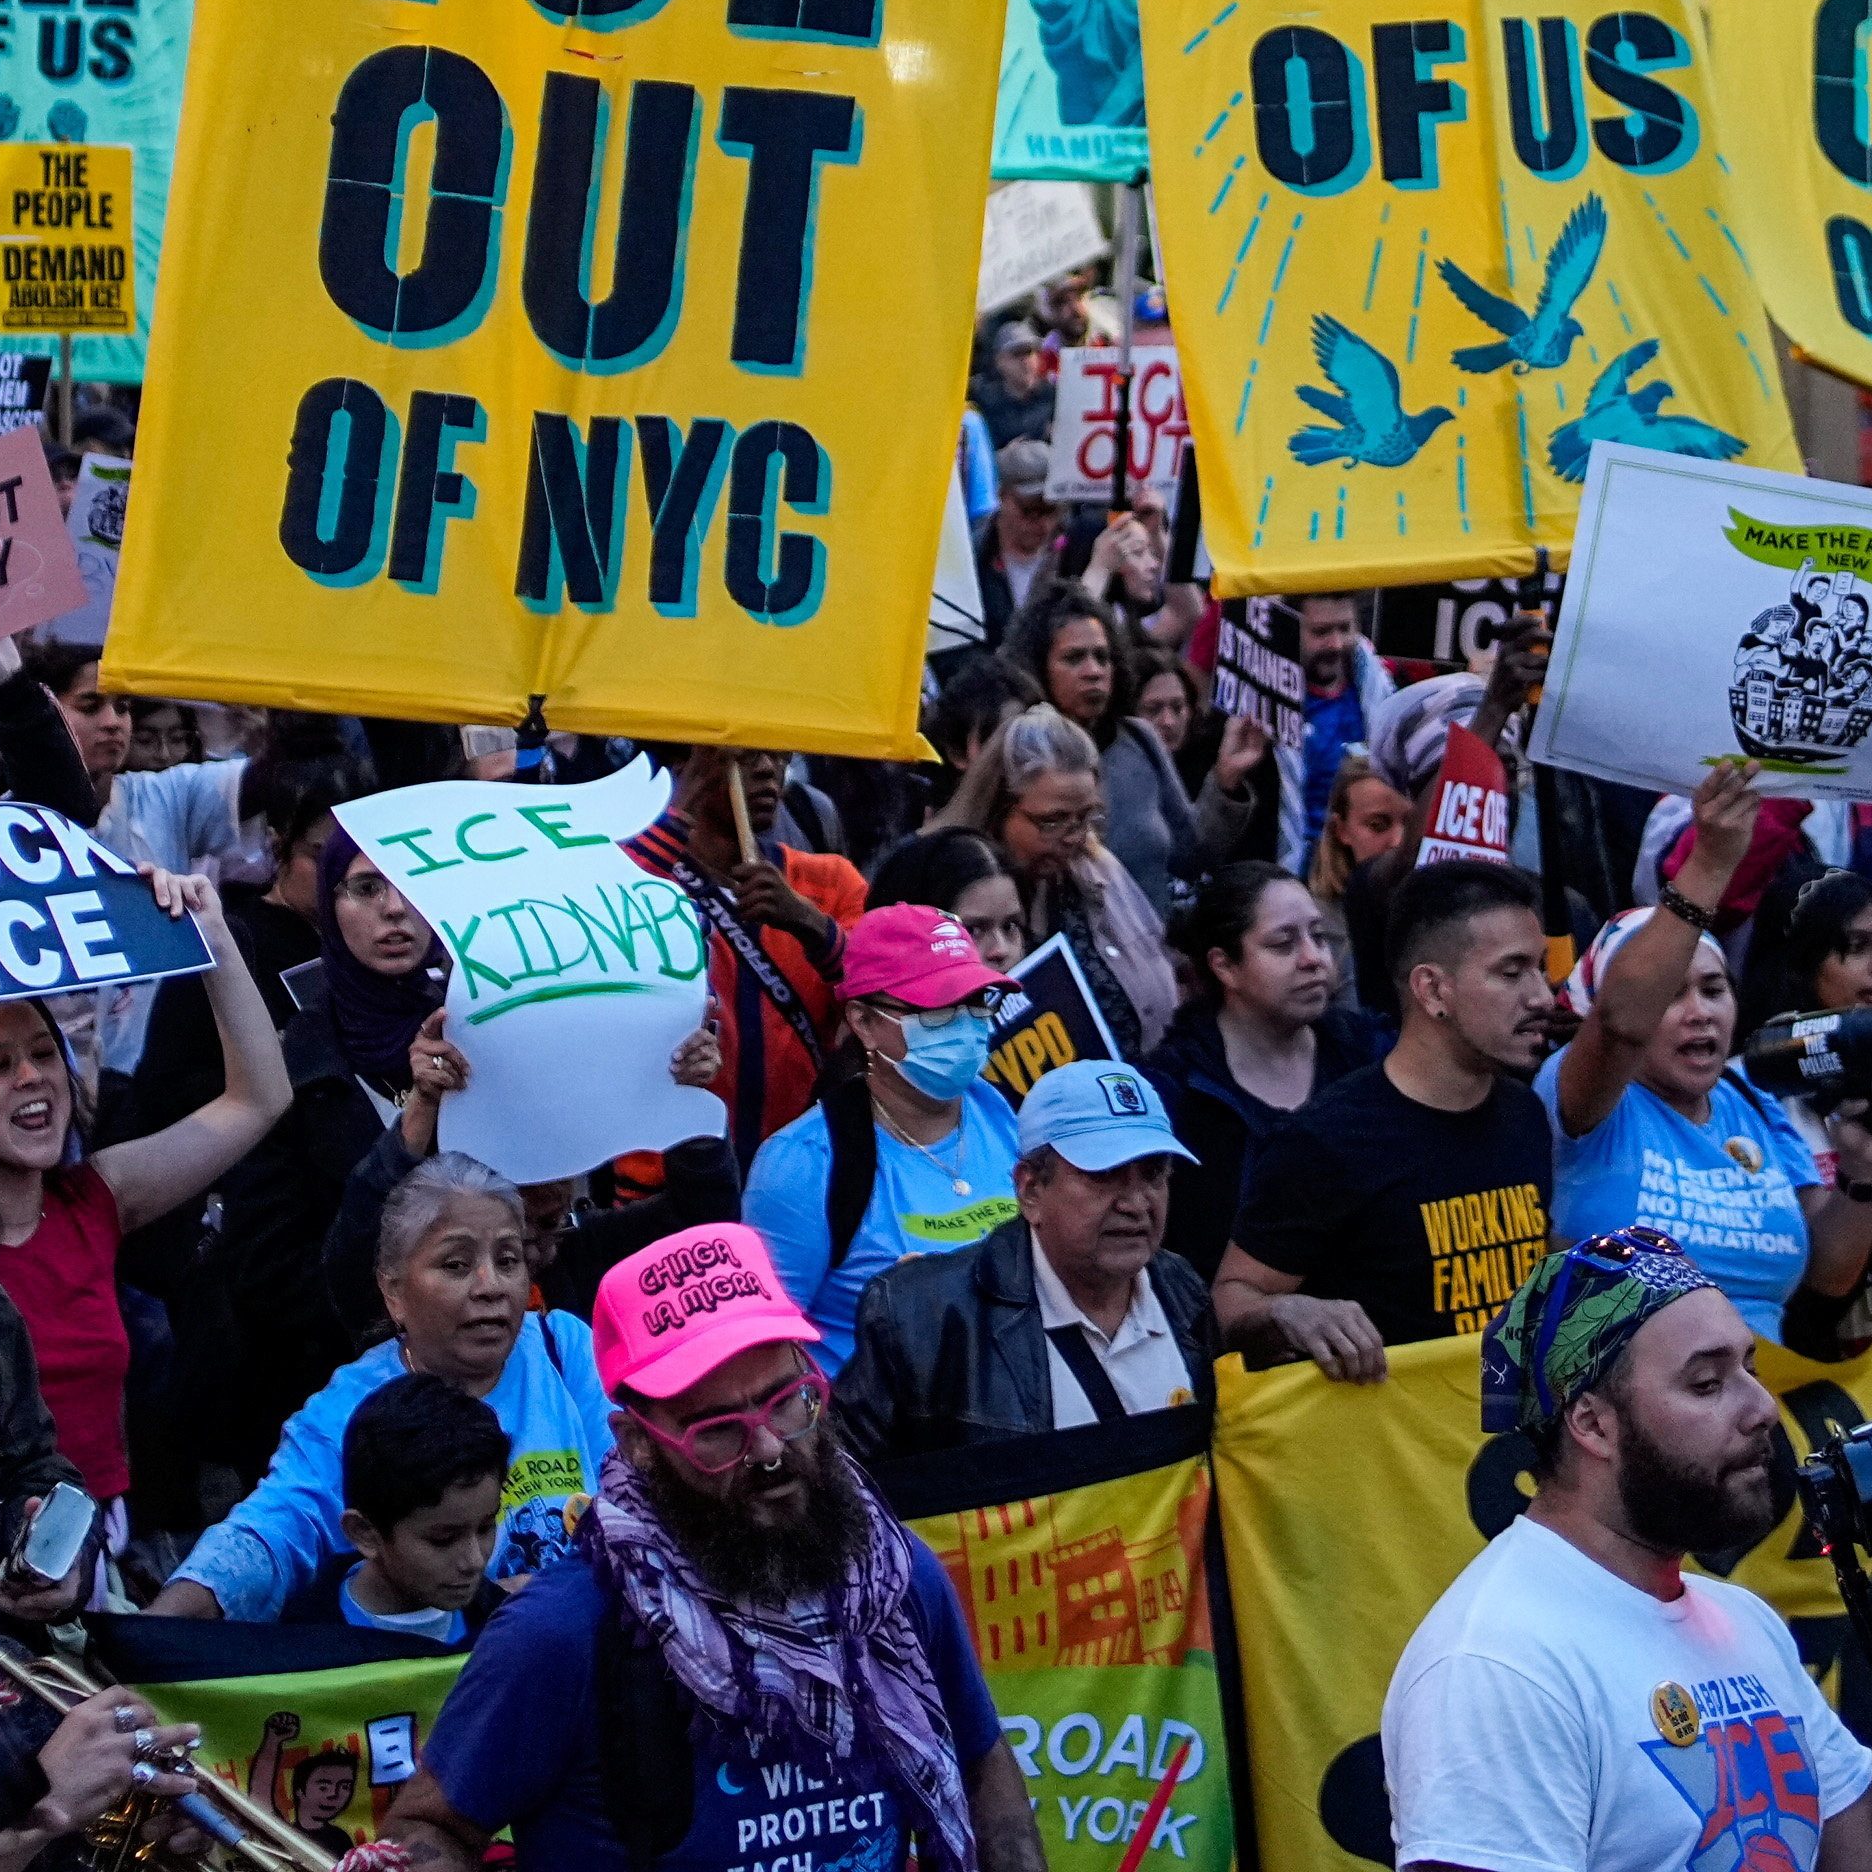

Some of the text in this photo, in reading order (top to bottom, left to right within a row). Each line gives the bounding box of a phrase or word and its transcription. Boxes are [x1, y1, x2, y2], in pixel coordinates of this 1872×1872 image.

[37, 15, 137, 88] US
[1249, 8, 1702, 200] OF US
[40, 150, 88, 188] THE
[12, 190, 113, 229] PEOPLE
[317, 44, 864, 379] OUT
[2, 245, 126, 282] DEMAND
[9, 284, 121, 309] ABOLISH ICE!
[1076, 424, 1192, 480] OUT
[276, 374, 834, 628] OF NYC
[1744, 526, 1809, 550] MAKE
[1815, 532, 1861, 549] THE
[1827, 553, 1869, 571] NEW
[1434, 780, 1484, 841] ICE
[378, 802, 612, 878] ICE
[1636, 1190, 1764, 1229] NO FAMILY
[1640, 1169, 1676, 1194] NO
[924, 1205, 995, 1230] MAKE THE
[1419, 1182, 1549, 1257] WORKING
[1635, 1215, 1800, 1255] SEPARATION.
[639, 1238, 742, 1296] CHINGA
[642, 1271, 772, 1337] LA MIGRA
[513, 1477, 583, 1501] NEW YORK
[526, 1457, 579, 1476] ROAD
[1691, 1674, 1776, 1719] ABOLISH
[1000, 1711, 1205, 1782] ROAD
[1698, 1715, 1820, 1849] ICE
[737, 1793, 885, 1852] PROTECT
[1056, 1794, 1199, 1858] YORK
